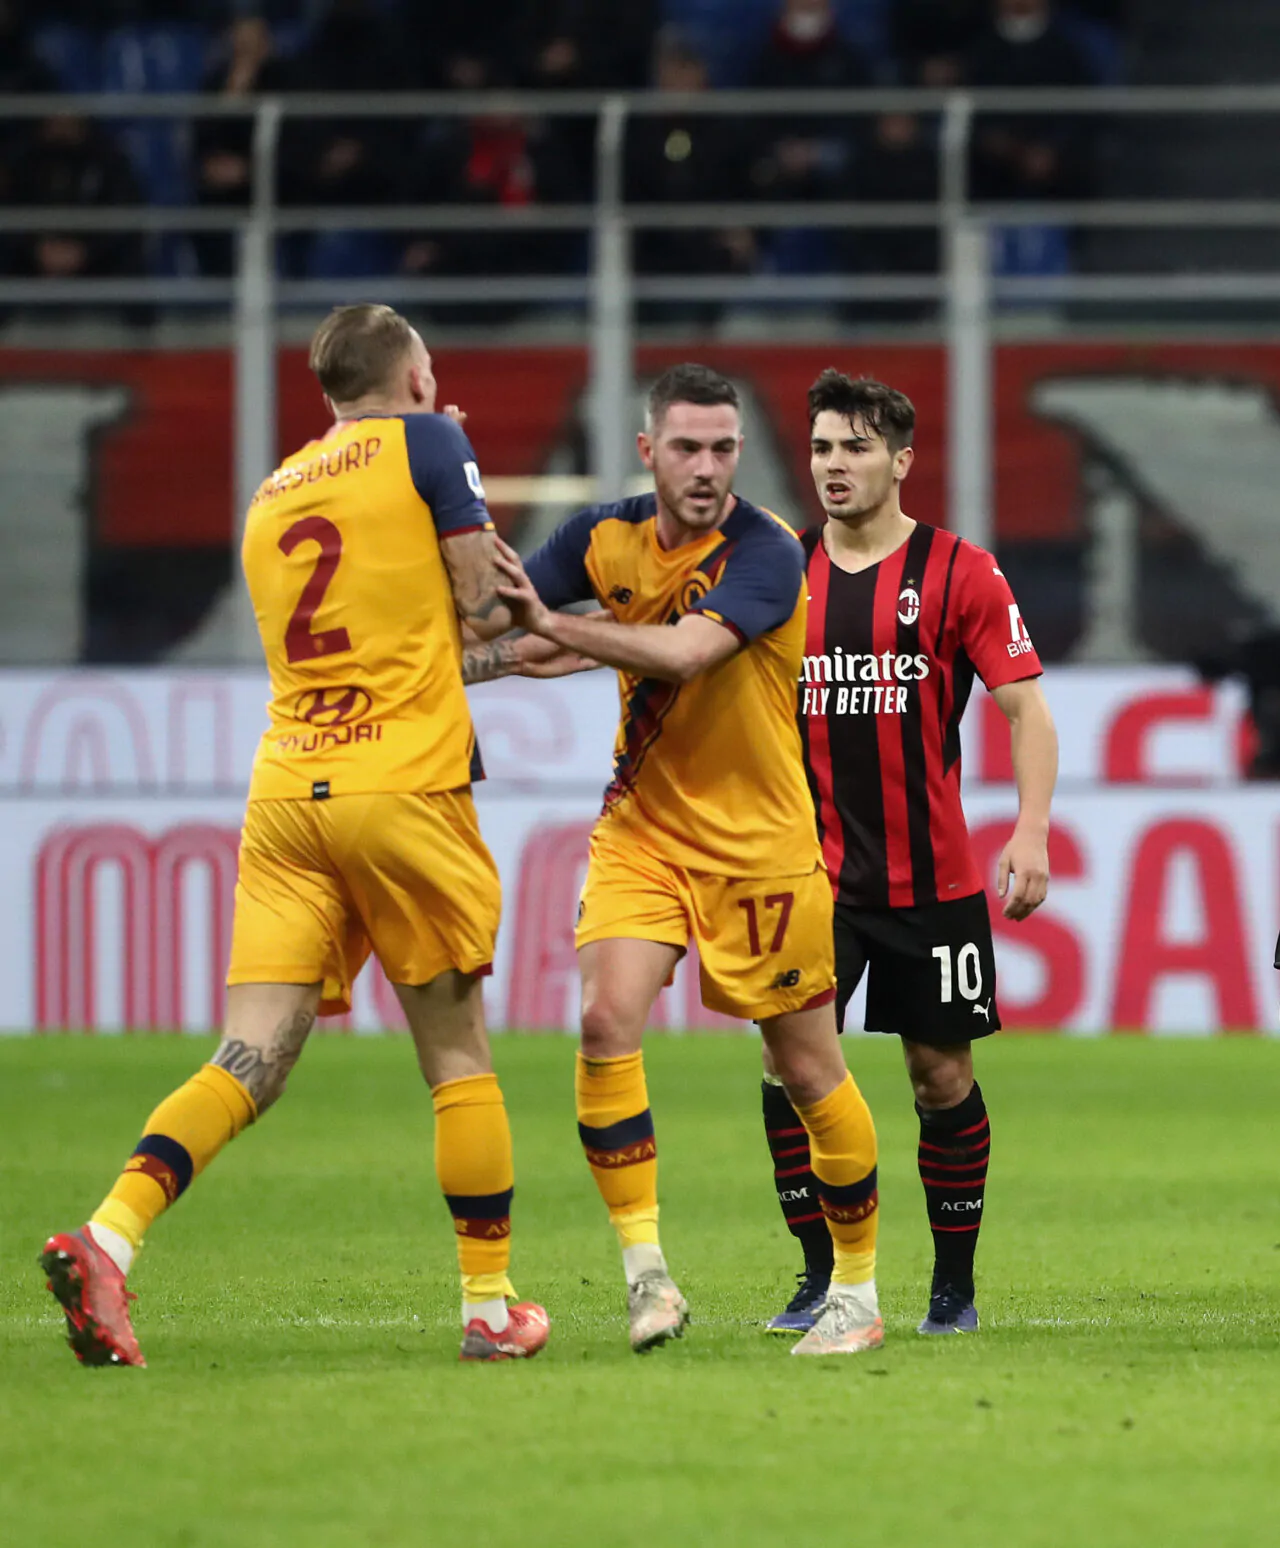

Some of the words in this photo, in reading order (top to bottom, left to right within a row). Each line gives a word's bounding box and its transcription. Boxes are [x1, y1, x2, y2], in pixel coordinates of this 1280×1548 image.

[277, 516, 352, 664] 2
[797, 646, 930, 683] mirates
[802, 687, 830, 715] FLY
[836, 686, 908, 715] BETTER
[738, 892, 794, 957] 17
[932, 942, 983, 1003] 10
[941, 1199, 983, 1213] ACM
